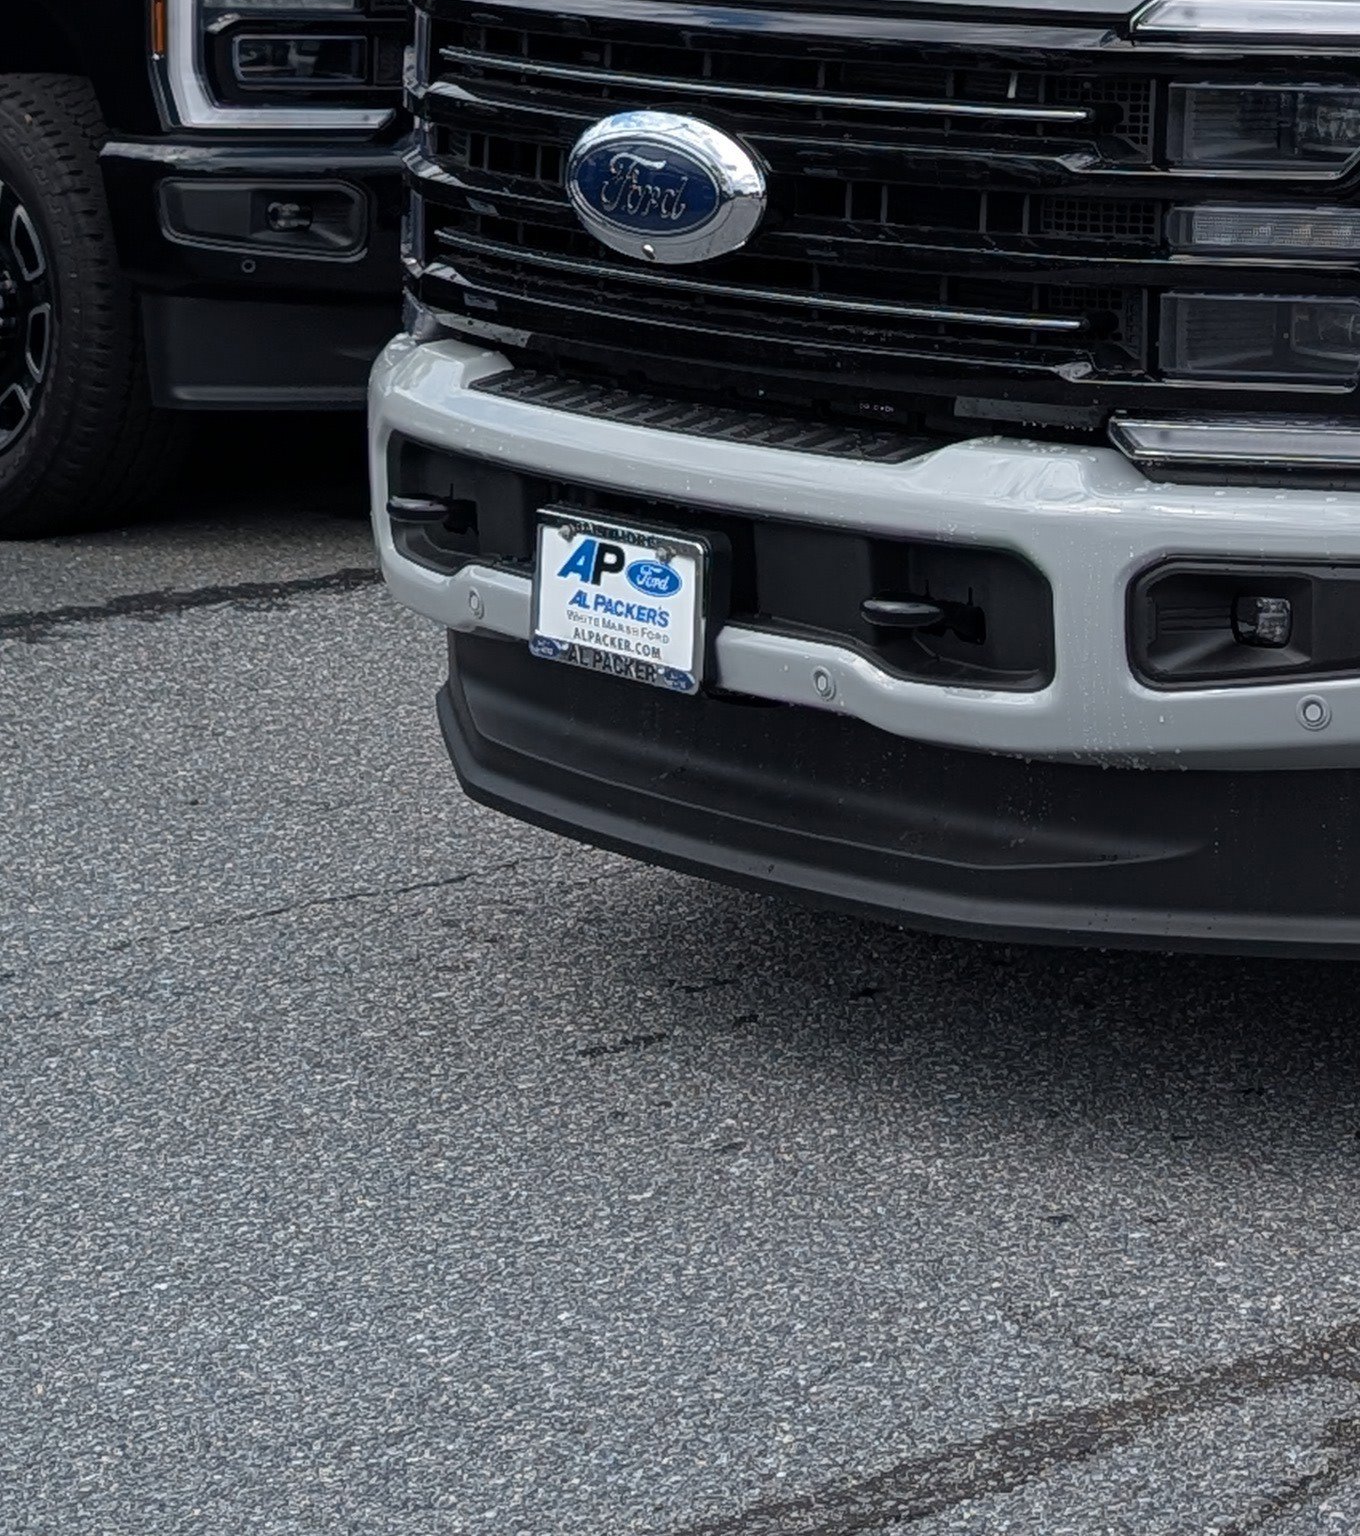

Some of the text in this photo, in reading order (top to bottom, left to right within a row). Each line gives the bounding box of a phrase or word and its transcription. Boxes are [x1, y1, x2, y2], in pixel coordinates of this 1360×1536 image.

[601, 151, 689, 221] Ford
[557, 538, 670, 591] AP Ford
[569, 590, 670, 628] AL PACKER'S
[573, 627, 662, 659] ALPACKER.COM
[641, 627, 670, 645] FORD
[567, 644, 589, 665] AL
[593, 648, 658, 683] PACKER
